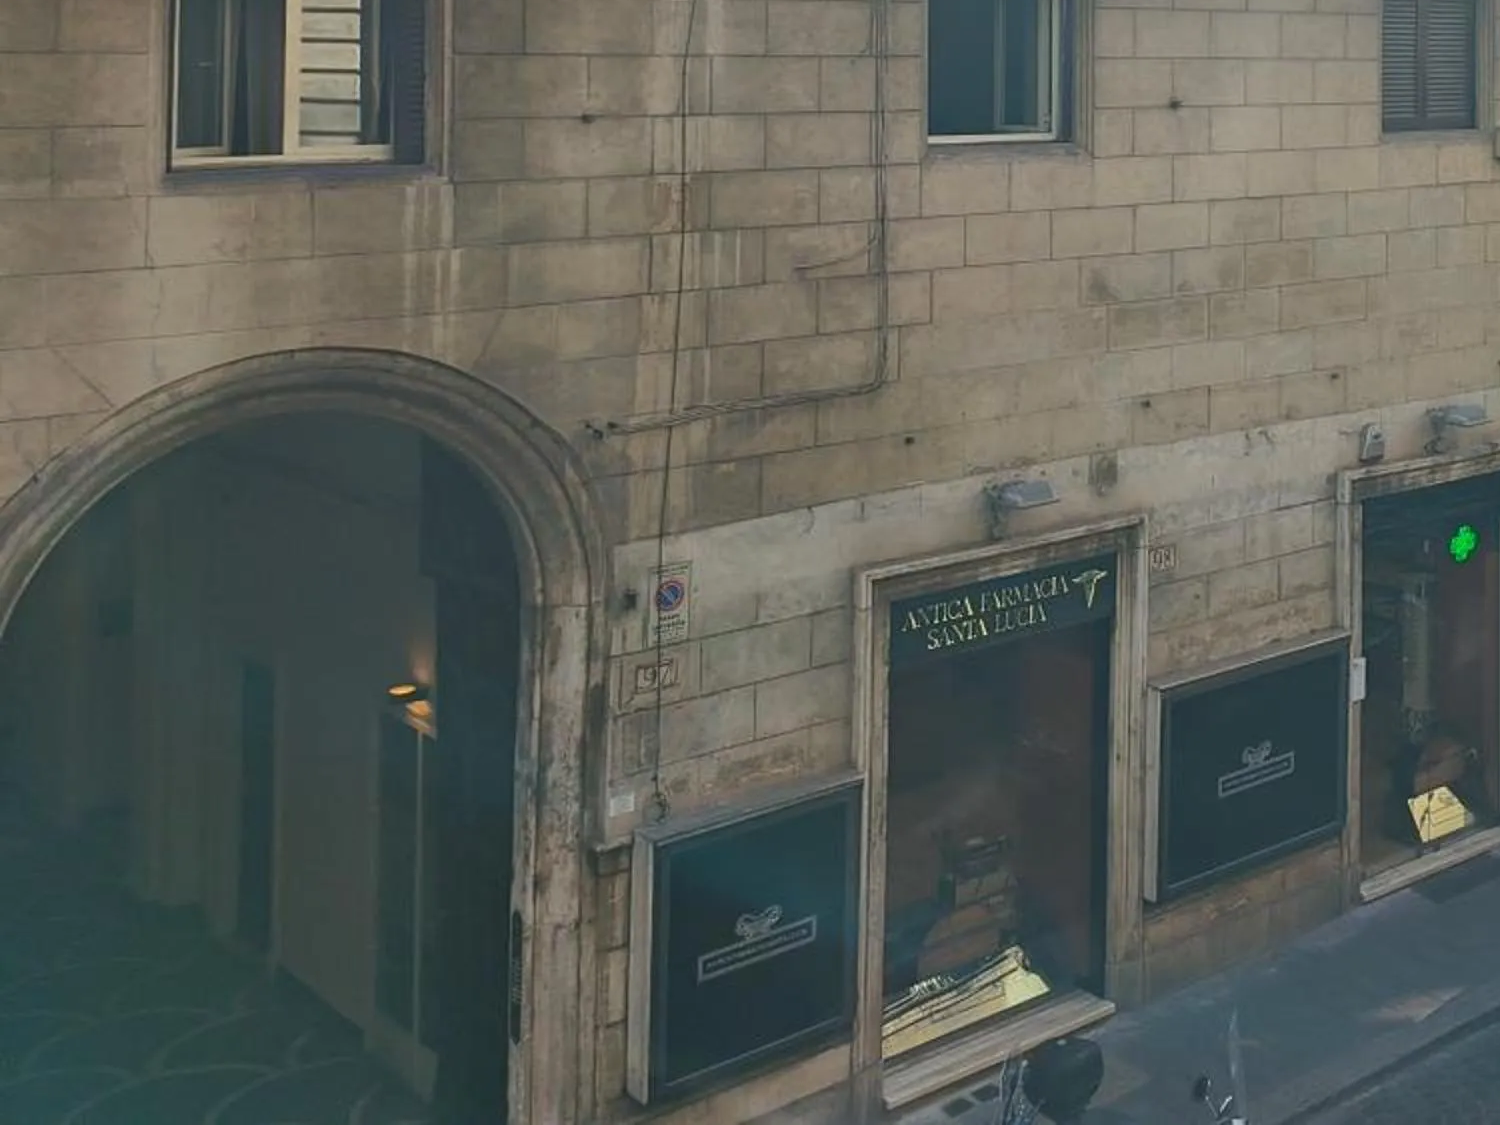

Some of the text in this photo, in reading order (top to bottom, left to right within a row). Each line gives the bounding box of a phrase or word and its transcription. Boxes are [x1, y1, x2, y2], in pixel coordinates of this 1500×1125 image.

[901, 574, 1070, 633] ANTICA FARMACIA
[927, 602, 1048, 651] SANTA LUCIA
